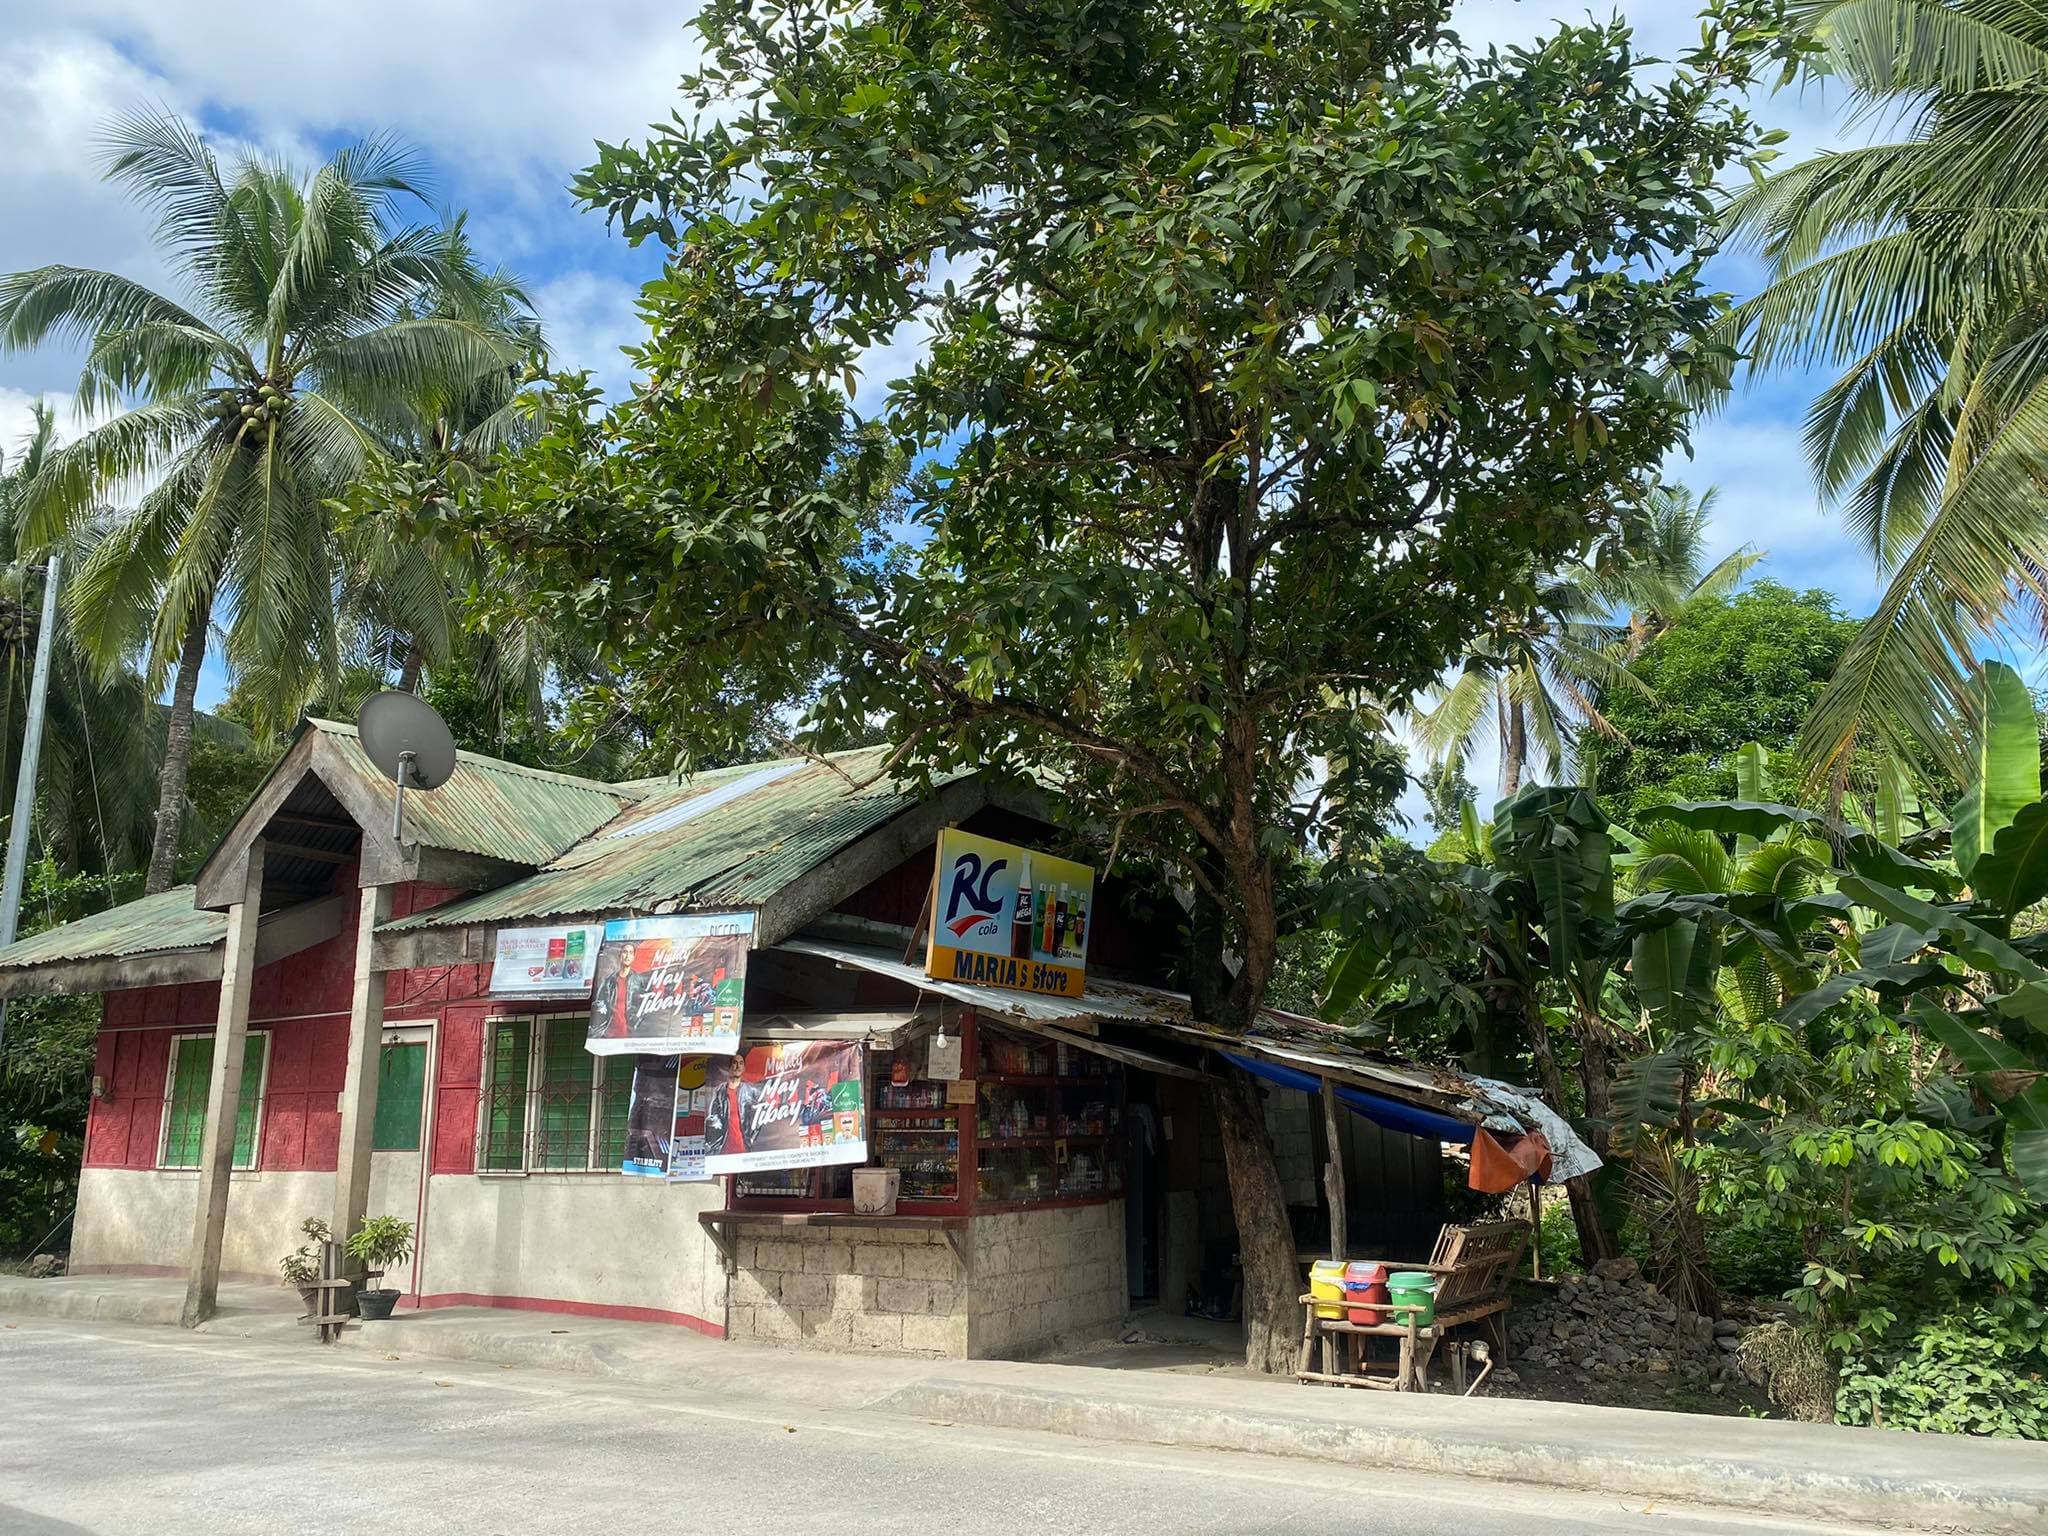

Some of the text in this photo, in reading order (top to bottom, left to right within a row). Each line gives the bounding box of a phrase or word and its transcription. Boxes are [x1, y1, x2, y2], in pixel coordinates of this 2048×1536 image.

[945, 852, 1008, 923] RC
[978, 922, 998, 936] cola
[652, 949, 692, 968] Mighty
[645, 969, 685, 992] May
[953, 951, 1068, 992] MARIA's store
[636, 991, 687, 1018] Tibay
[765, 1055, 804, 1075] Mighty
[758, 1078, 800, 1101] May
[750, 1100, 803, 1131] Tibay
[633, 1157, 663, 1167] STABILITY
